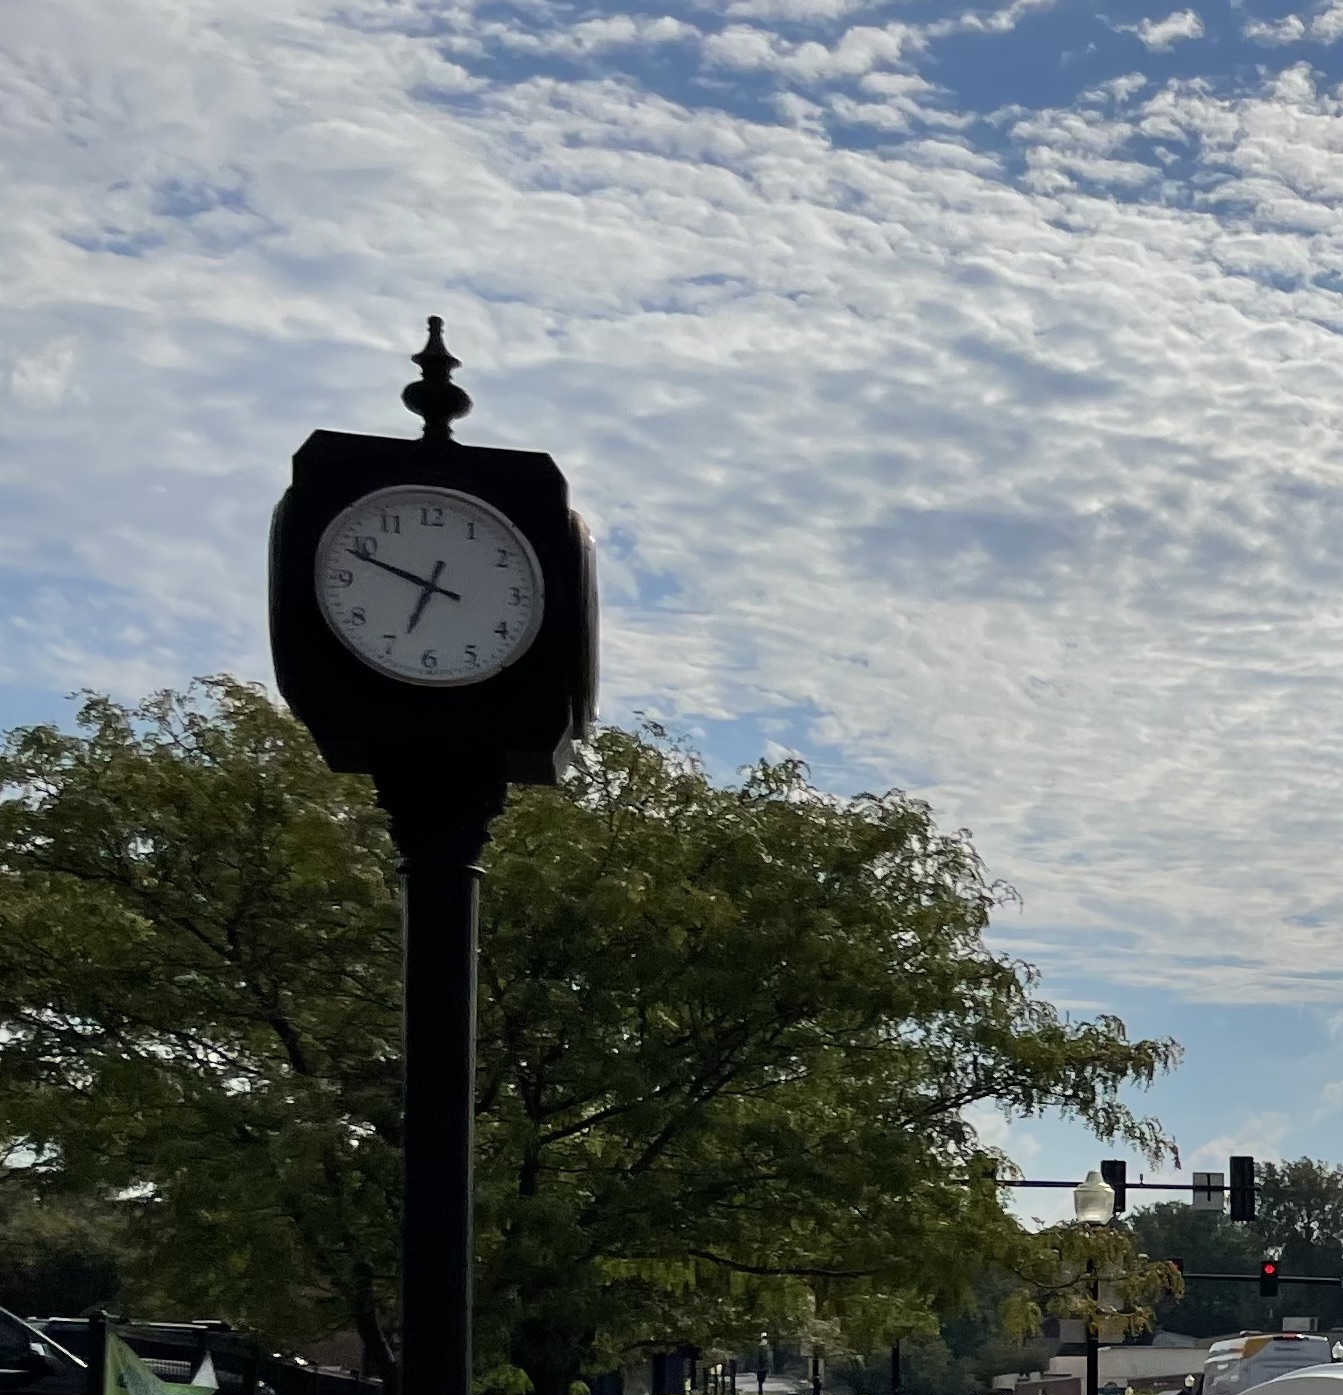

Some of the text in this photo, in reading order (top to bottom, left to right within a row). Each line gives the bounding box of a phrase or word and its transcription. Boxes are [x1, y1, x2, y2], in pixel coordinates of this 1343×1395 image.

[380, 514, 401, 534] 11
[420, 507, 444, 528] 12
[465, 521, 477, 541] 1
[353, 535, 379, 558] 10
[494, 548, 510, 568] 2
[338, 569, 354, 587] 9
[508, 587, 522, 607] 3
[350, 606, 367, 626] 8
[493, 621, 510, 640] 4
[383, 633, 397, 655] 7
[420, 649, 438, 668] 6
[464, 644, 481, 667] 5
